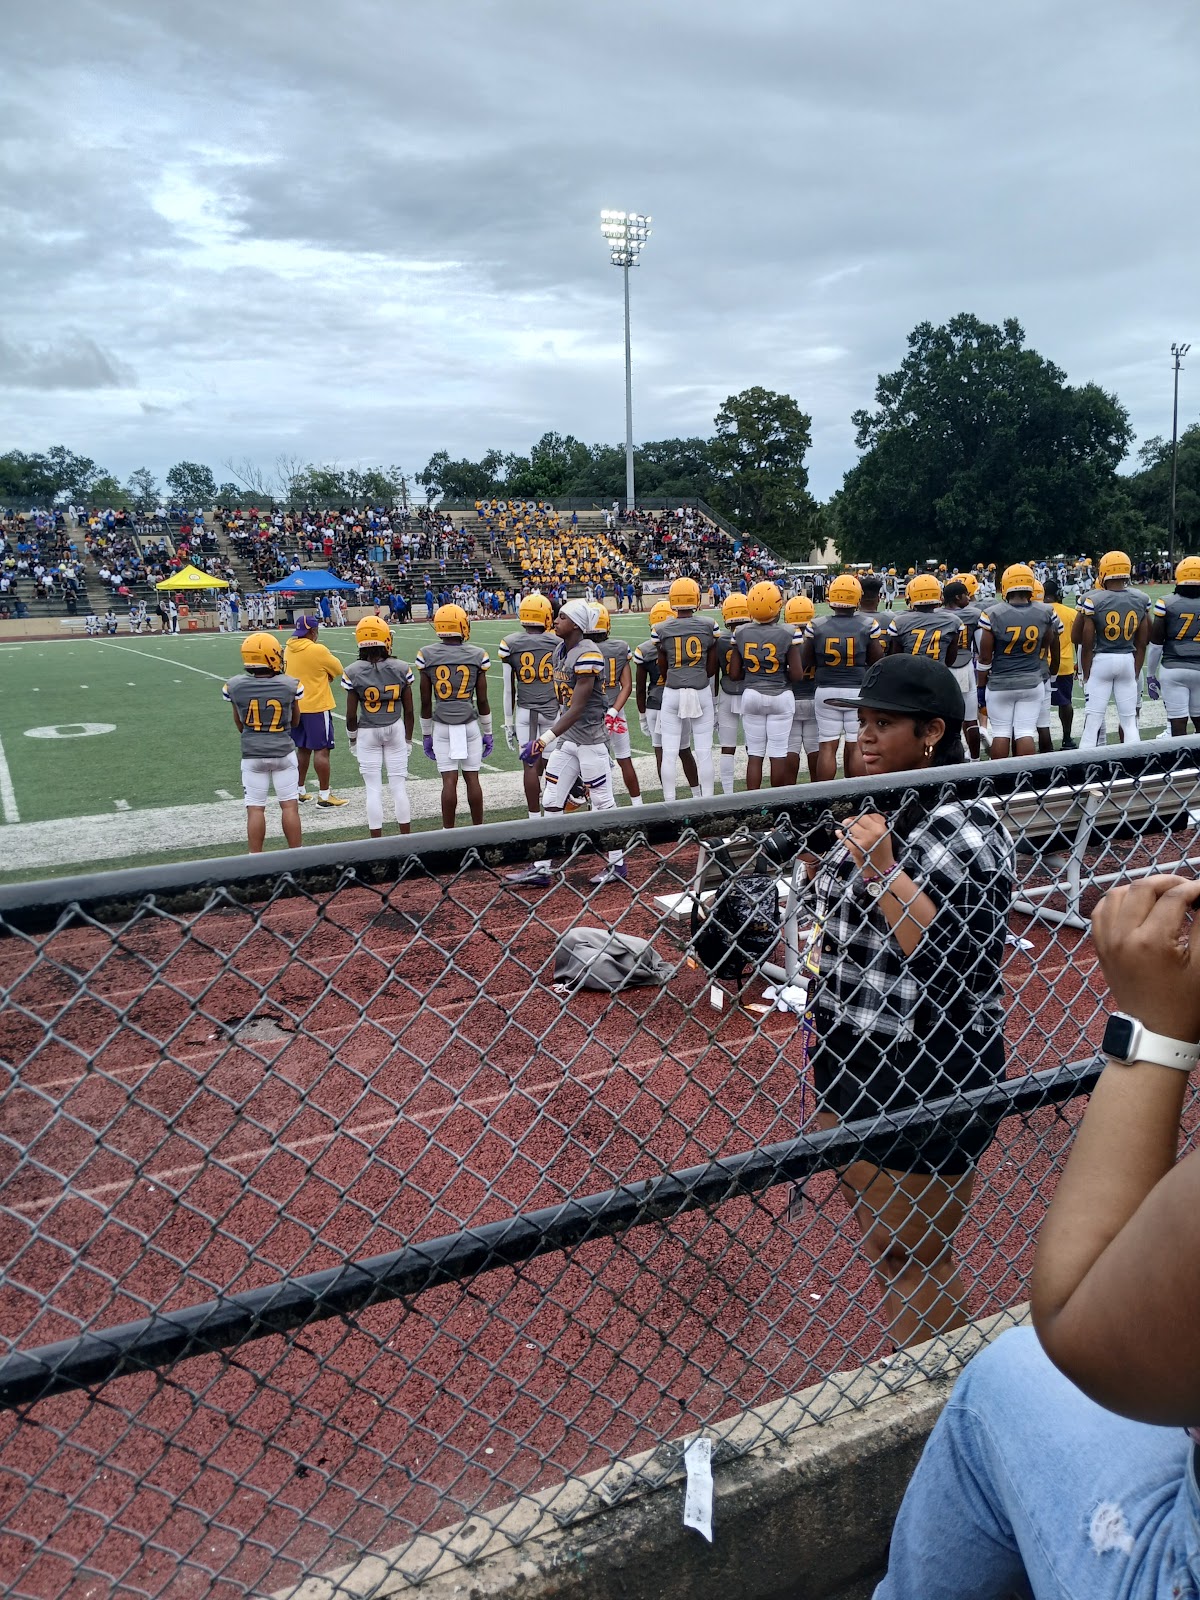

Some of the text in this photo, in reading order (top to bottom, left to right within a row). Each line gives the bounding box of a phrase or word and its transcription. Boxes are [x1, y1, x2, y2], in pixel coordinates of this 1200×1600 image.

[1004, 625, 1039, 654] 78
[1104, 610, 1139, 641] 80
[673, 636, 703, 668] 19
[744, 642, 780, 673] 53
[825, 637, 855, 667] 51
[911, 629, 941, 660] 74
[435, 665, 471, 699] 82
[519, 651, 553, 684] 86
[364, 683, 401, 714] 87
[245, 698, 284, 733] 42
